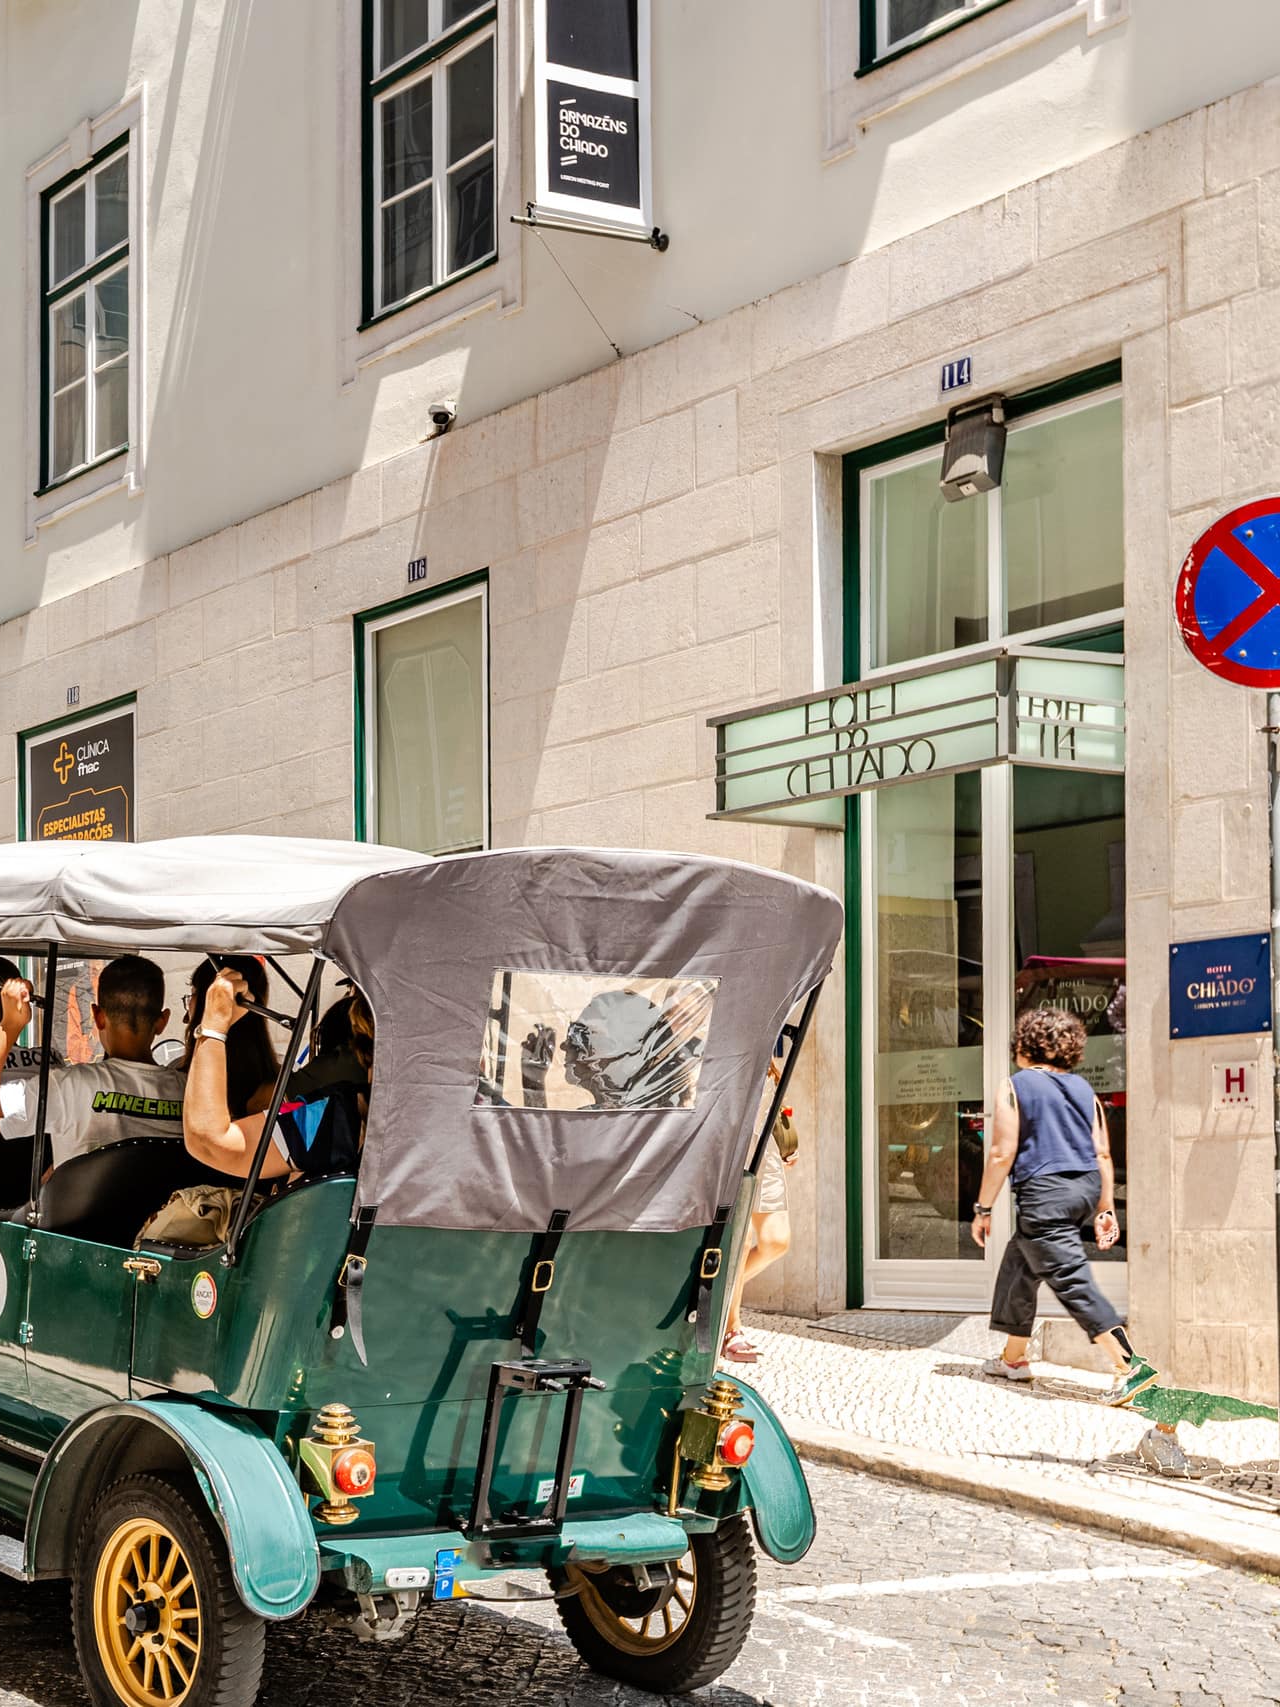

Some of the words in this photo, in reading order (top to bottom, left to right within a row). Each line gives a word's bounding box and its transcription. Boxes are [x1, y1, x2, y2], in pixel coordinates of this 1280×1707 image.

[559, 108, 628, 135] ARMAZÉNS
[559, 122, 580, 138] DO
[559, 136, 609, 158] CHIADO
[943, 358, 969, 390] 114
[409, 559, 426, 582] 116
[76, 739, 110, 761] CLÍNICA
[77, 761, 100, 777] fnac
[787, 737, 936, 797] CHIADO
[43, 807, 106, 837] ESPECIALISTAS
[1225, 1067, 1245, 1093] H
[92, 1091, 185, 1119] MINECRA
[441, 1580, 449, 1590] P
